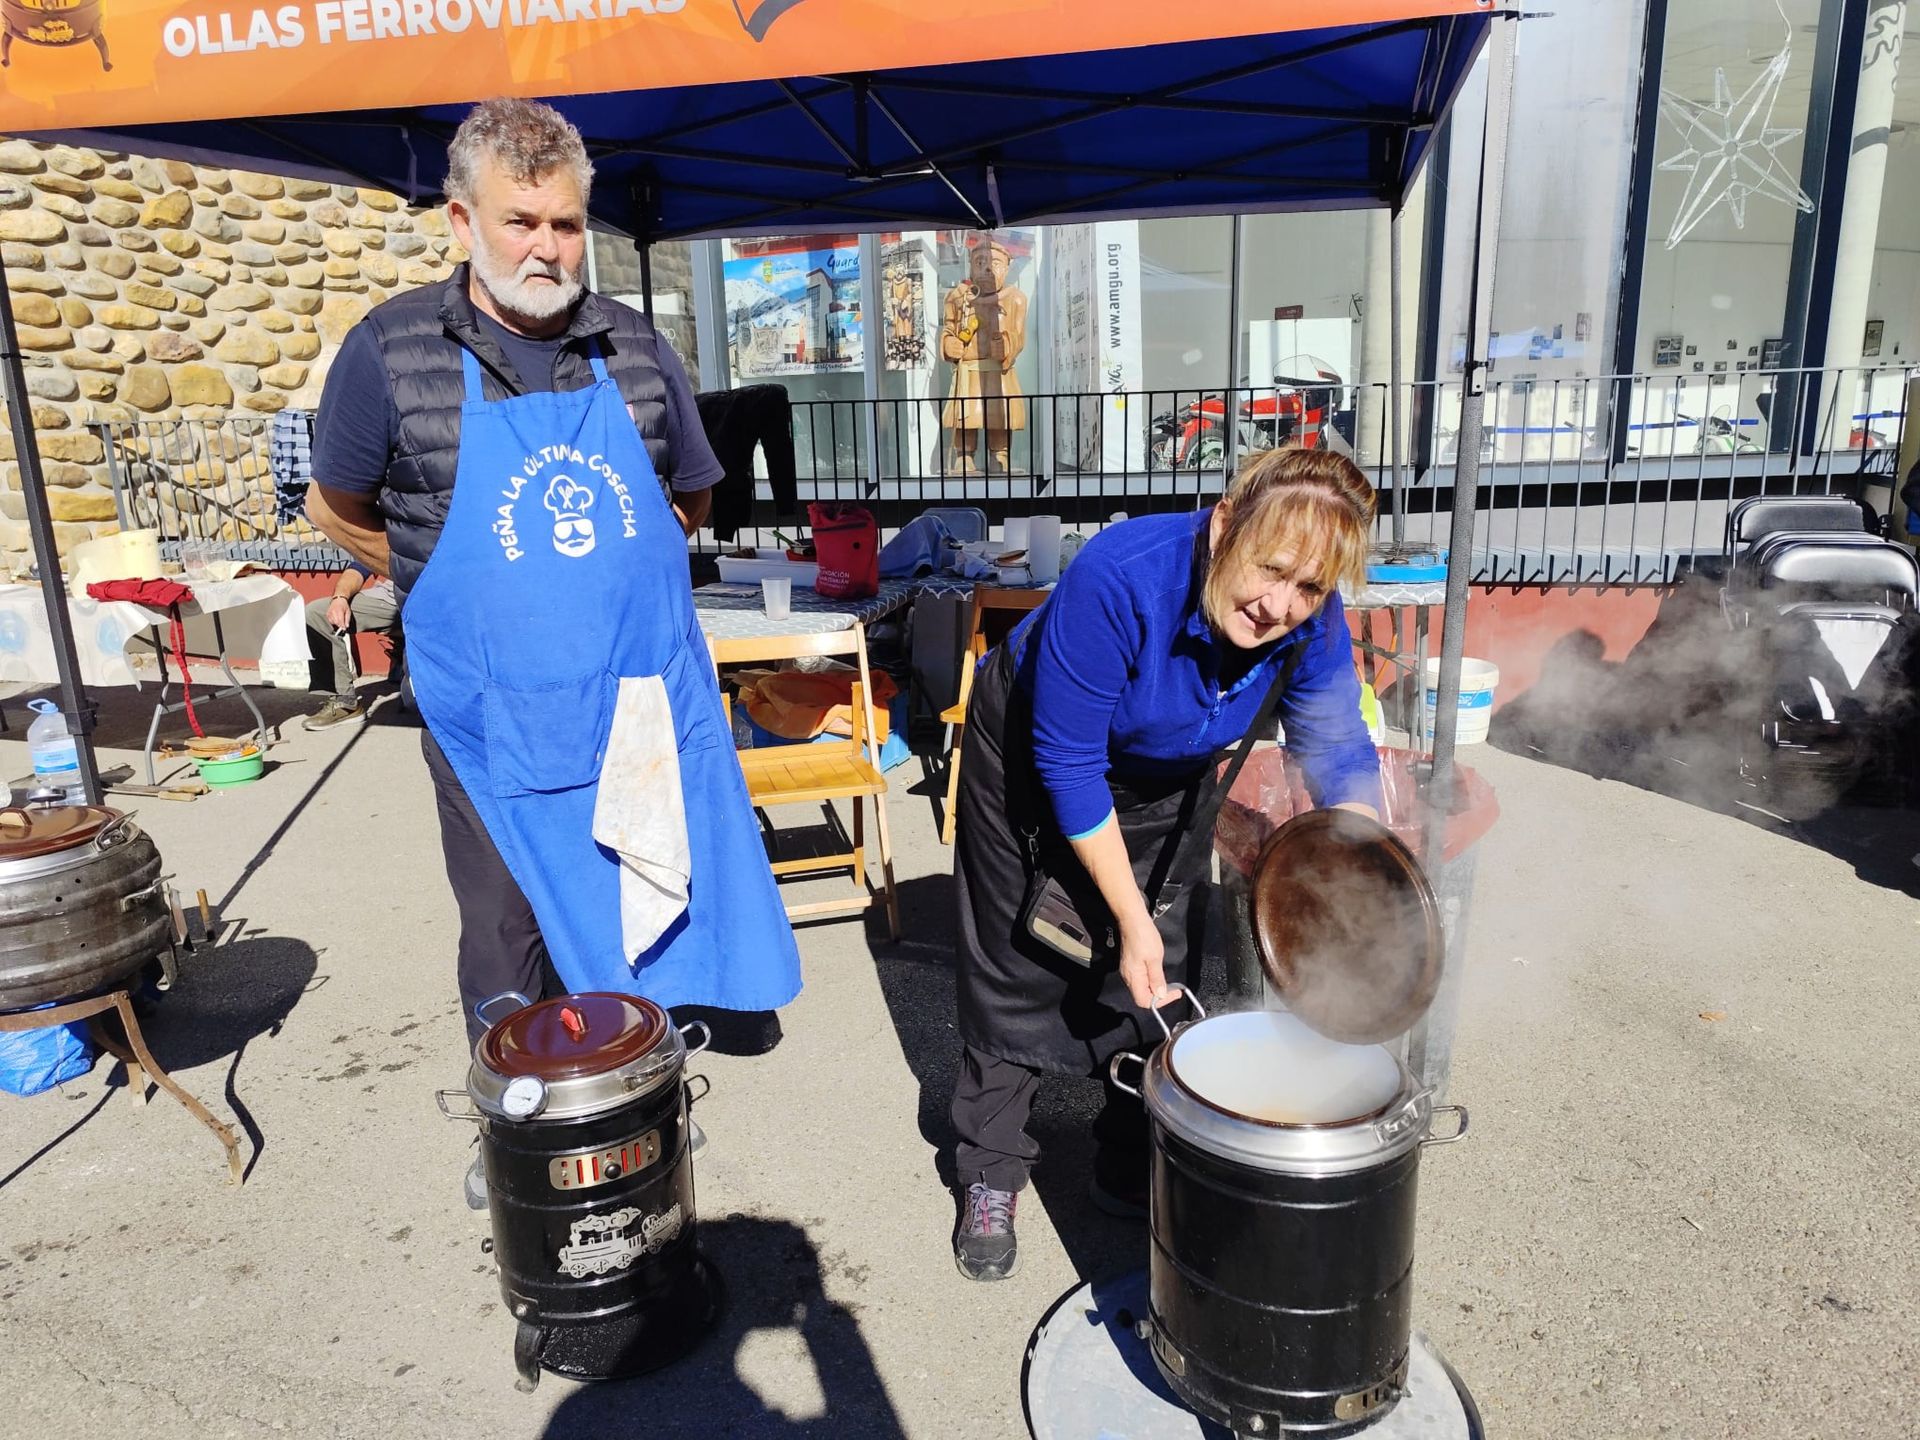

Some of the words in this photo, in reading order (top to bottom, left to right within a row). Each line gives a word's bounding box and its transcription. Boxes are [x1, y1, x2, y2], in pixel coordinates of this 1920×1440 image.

[163, 6, 305, 57] OLLAS
[1107, 243, 1123, 349] www.amgu.org
[502, 476, 528, 500] LA
[523, 444, 585, 477] ÚLTIMA
[588, 454, 637, 539] COSECHA
[492, 503, 525, 562] PEÑA
